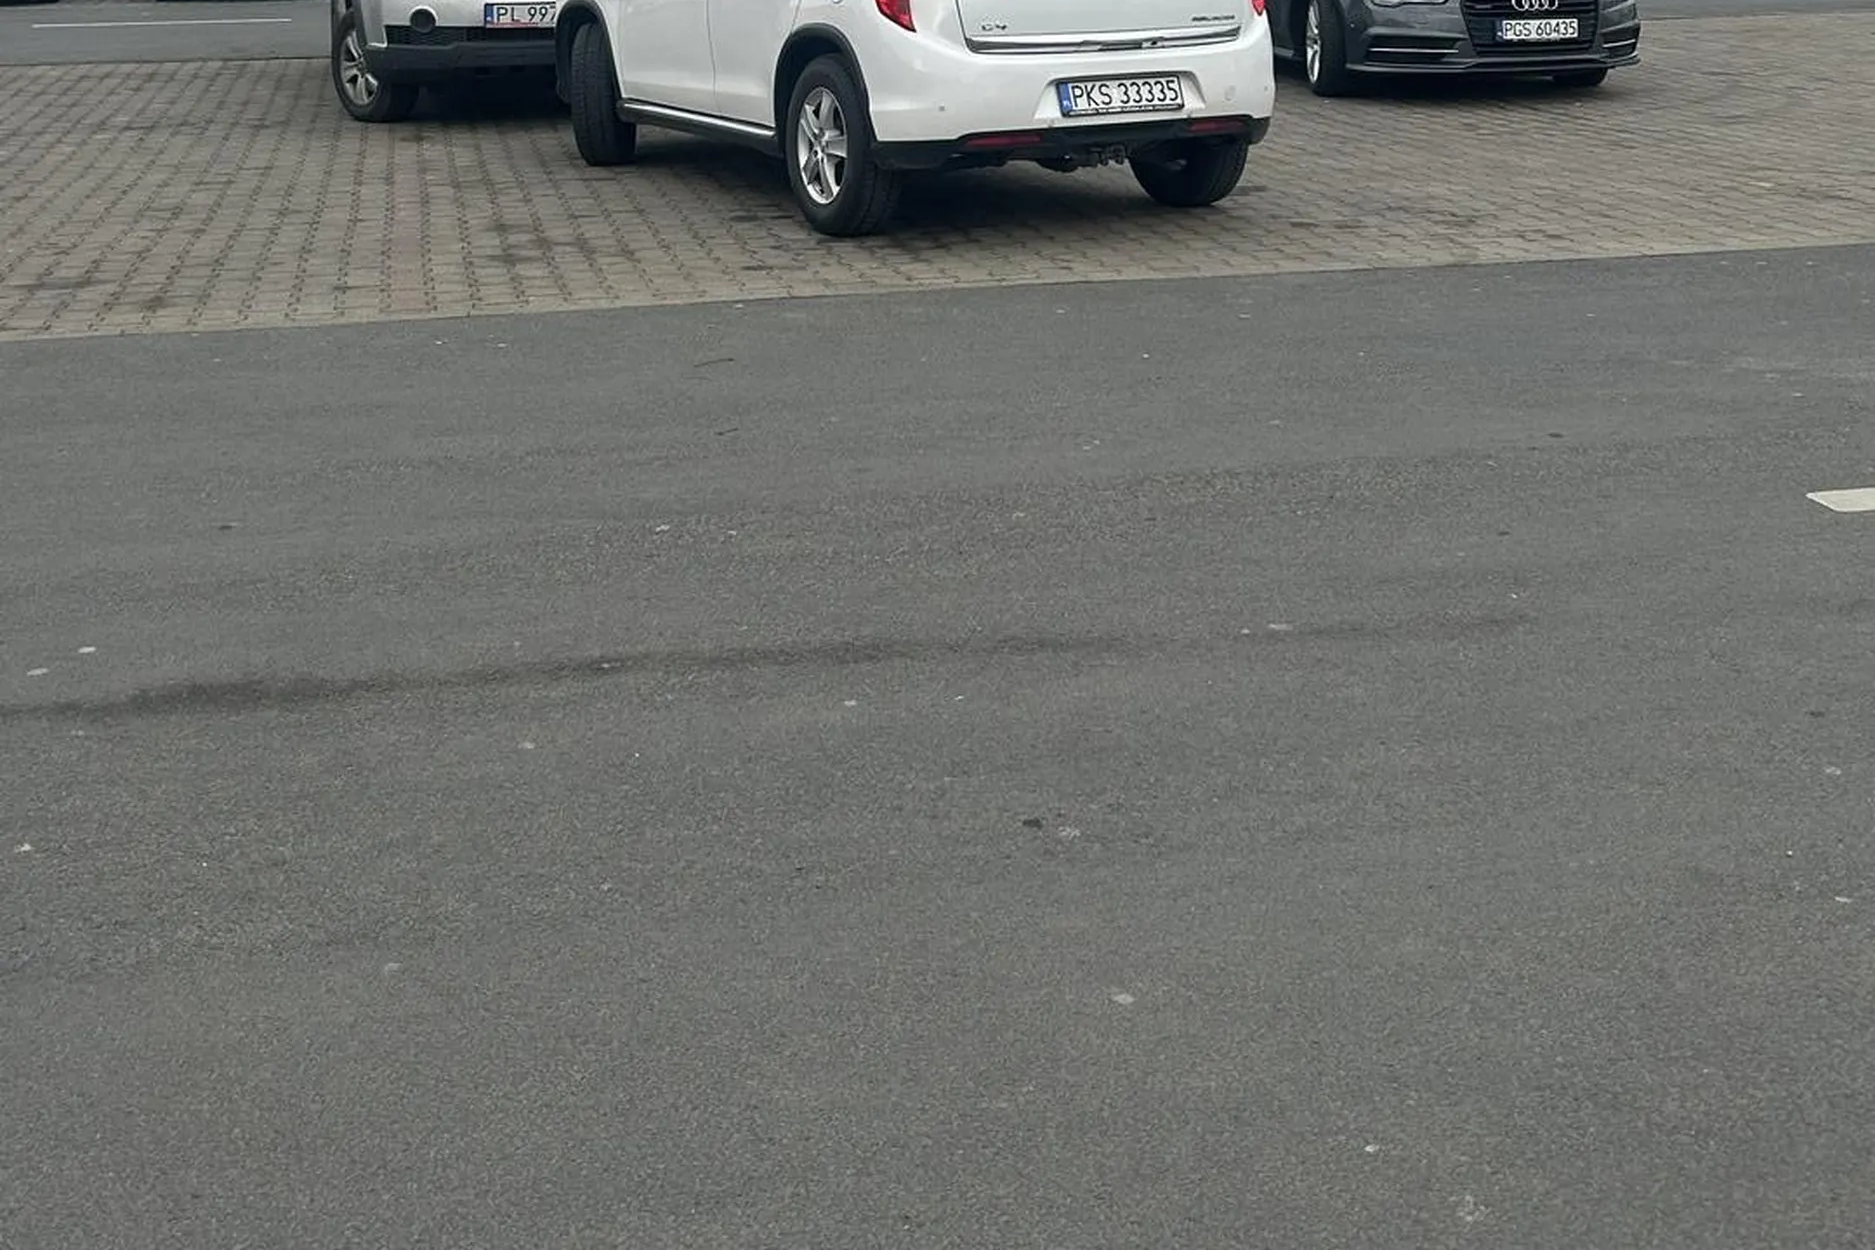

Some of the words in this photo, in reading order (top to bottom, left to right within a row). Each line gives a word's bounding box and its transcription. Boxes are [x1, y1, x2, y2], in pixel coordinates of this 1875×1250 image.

[496, 6, 521, 22] PL
[1505, 22, 1532, 37] PGS
[1536, 20, 1576, 36] 60435
[1071, 83, 1113, 107] PKS
[1117, 79, 1179, 104] 33335
